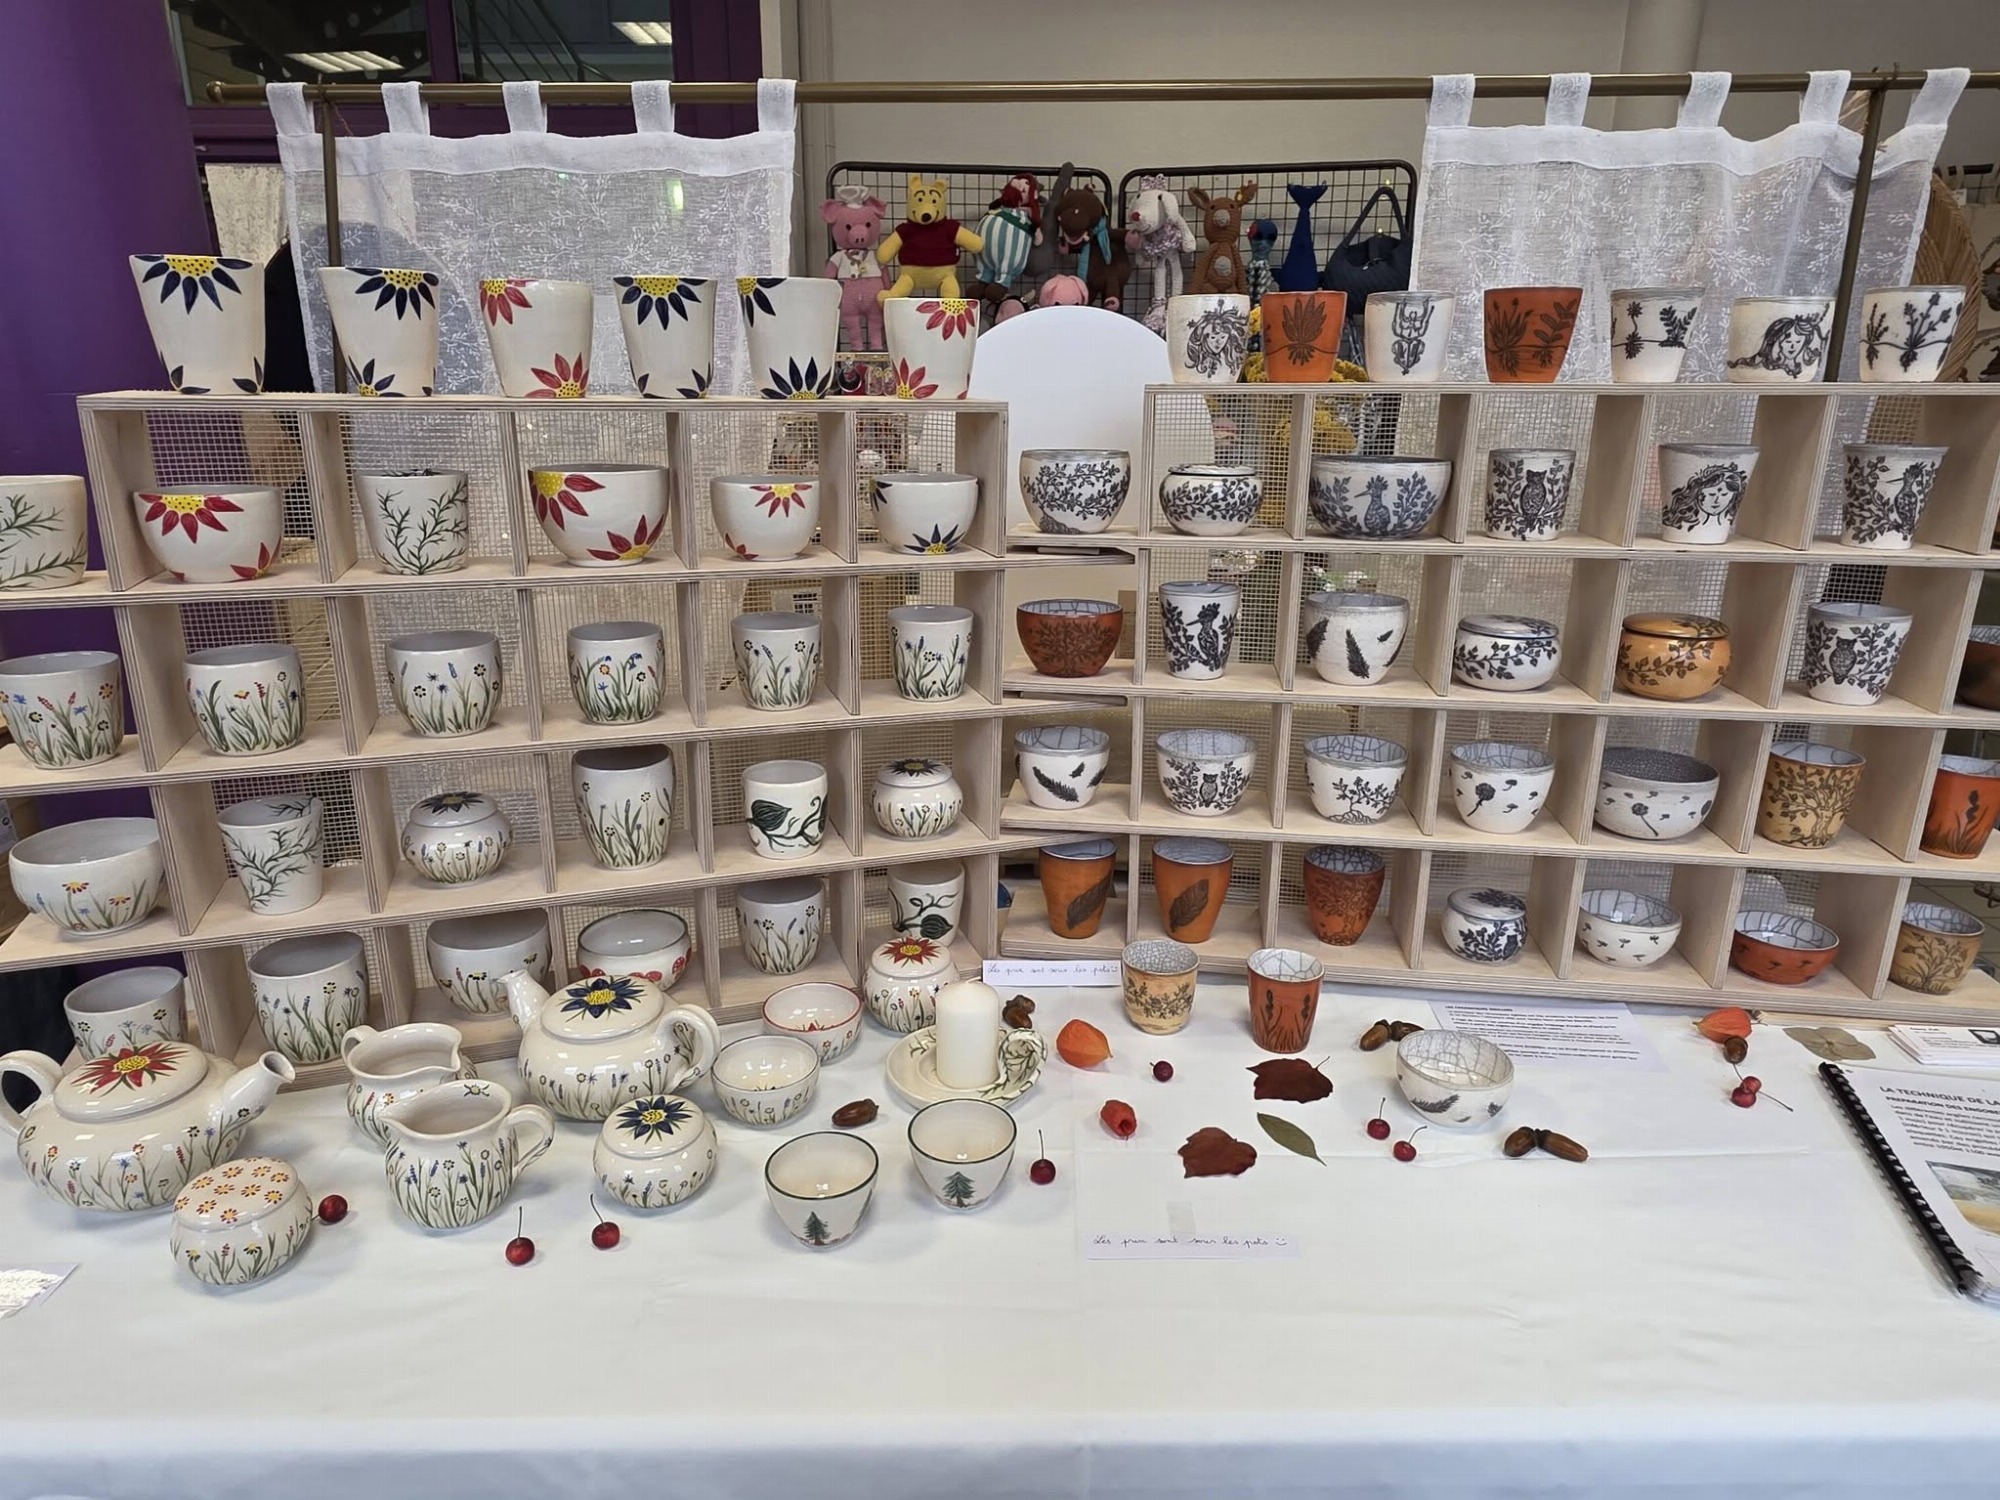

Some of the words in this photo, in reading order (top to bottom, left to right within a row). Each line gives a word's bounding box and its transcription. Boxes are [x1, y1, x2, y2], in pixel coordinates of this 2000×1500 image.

[1880, 1086, 1895, 1094] LA
[1896, 1088, 1965, 1102] TECHNIQUE
[1093, 1235, 1111, 1245] Les
[1222, 1236, 1239, 1245] les
